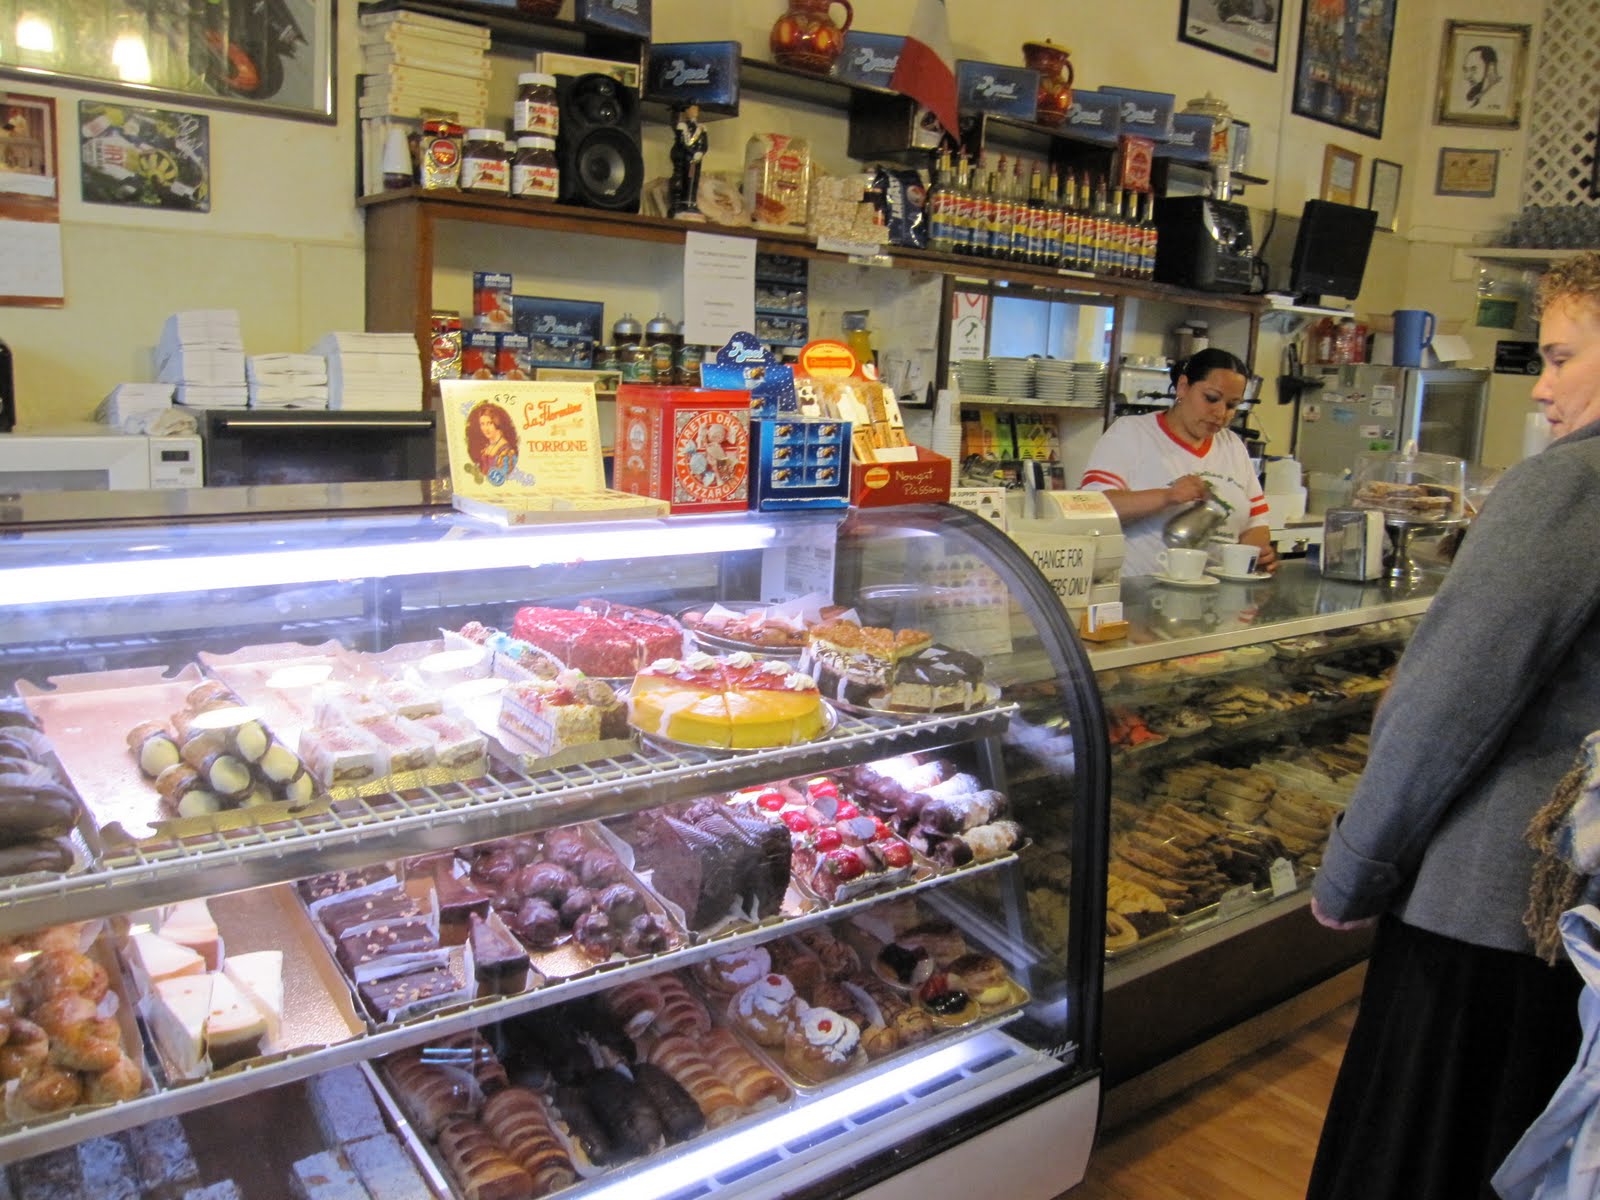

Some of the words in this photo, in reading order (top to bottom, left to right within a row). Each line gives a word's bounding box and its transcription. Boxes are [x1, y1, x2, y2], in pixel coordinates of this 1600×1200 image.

[526, 440, 588, 453] TORRONE
[677, 414, 712, 466] AMARETTI
[716, 413, 746, 465] ORIGINALI
[683, 474, 742, 499] LAZZARONI
[895, 467, 934, 485] Nougat
[903, 483, 943, 496] Passion
[1032, 550, 1065, 570] CHANGE
[1067, 548, 1084, 567] FOR
[1069, 576, 1090, 597] ONLY
